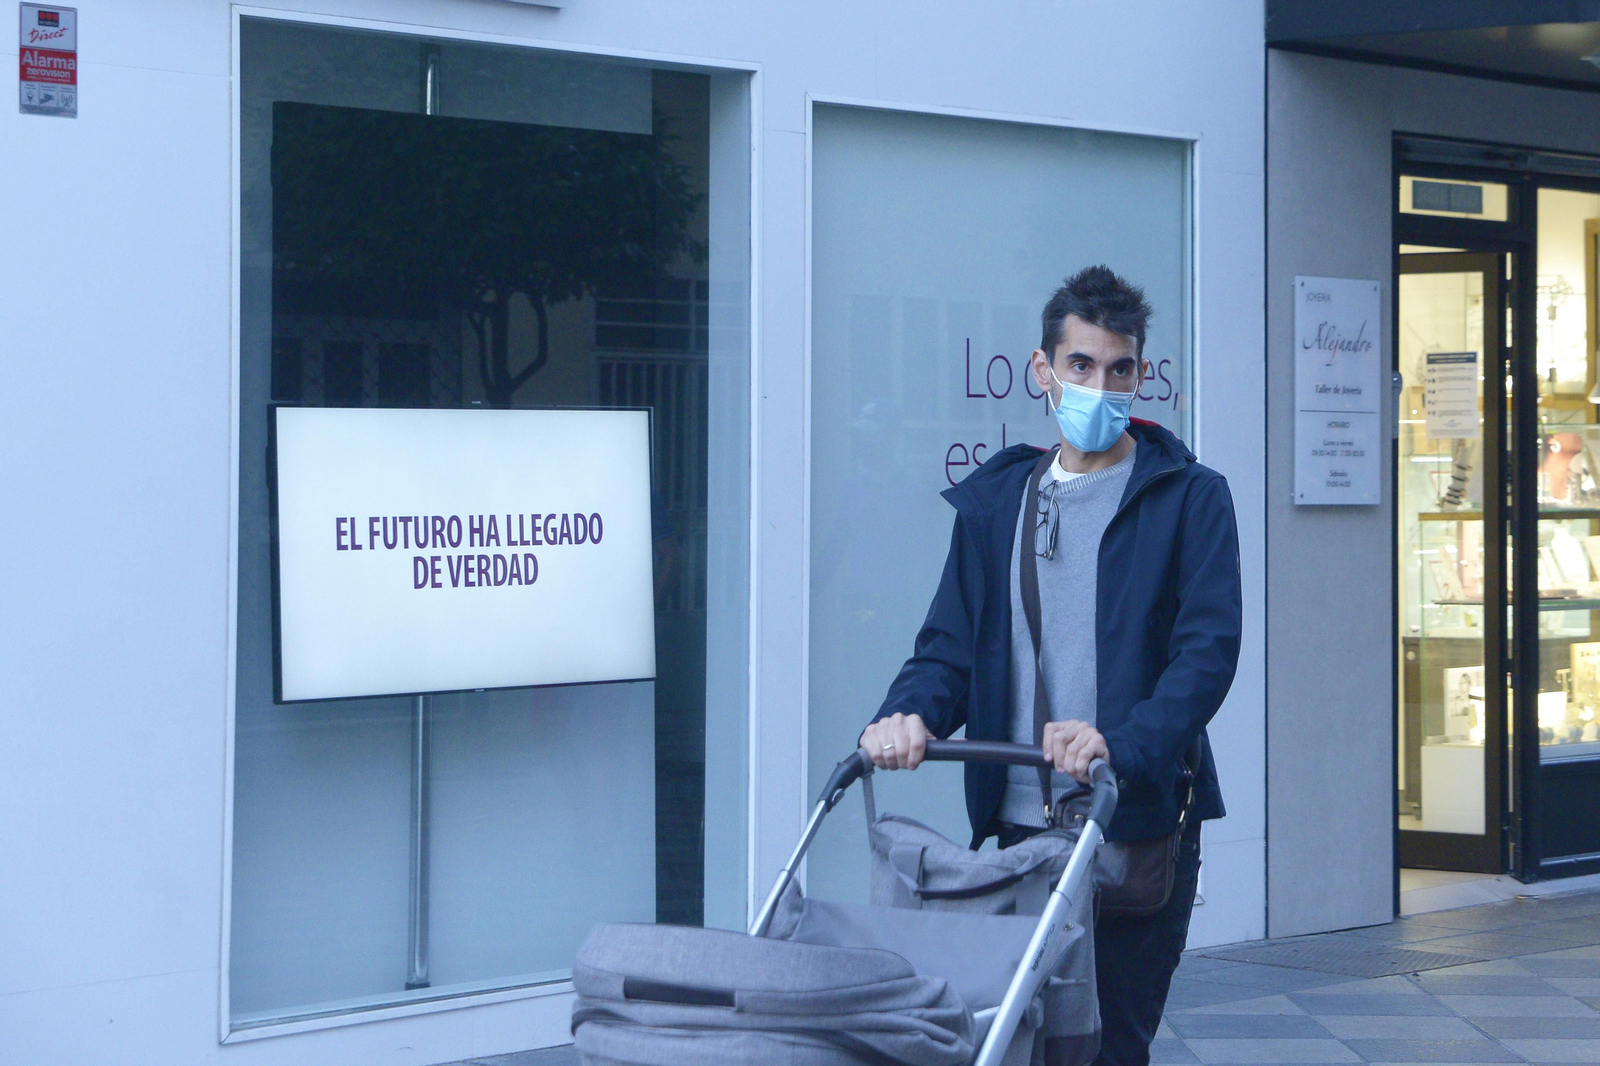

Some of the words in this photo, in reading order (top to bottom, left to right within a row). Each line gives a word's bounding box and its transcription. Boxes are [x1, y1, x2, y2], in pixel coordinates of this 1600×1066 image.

[29, 26, 70, 43] Direct
[22, 50, 76, 70] Alarma
[1302, 320, 1373, 367] Alejandro
[966, 338, 1013, 400] Lo
[336, 517, 363, 551] EL
[369, 515, 463, 550] FUTURO
[469, 514, 501, 547] HA
[506, 512, 603, 546] LLEGADO
[413, 556, 442, 589] DE
[447, 553, 539, 588] VERDAD
